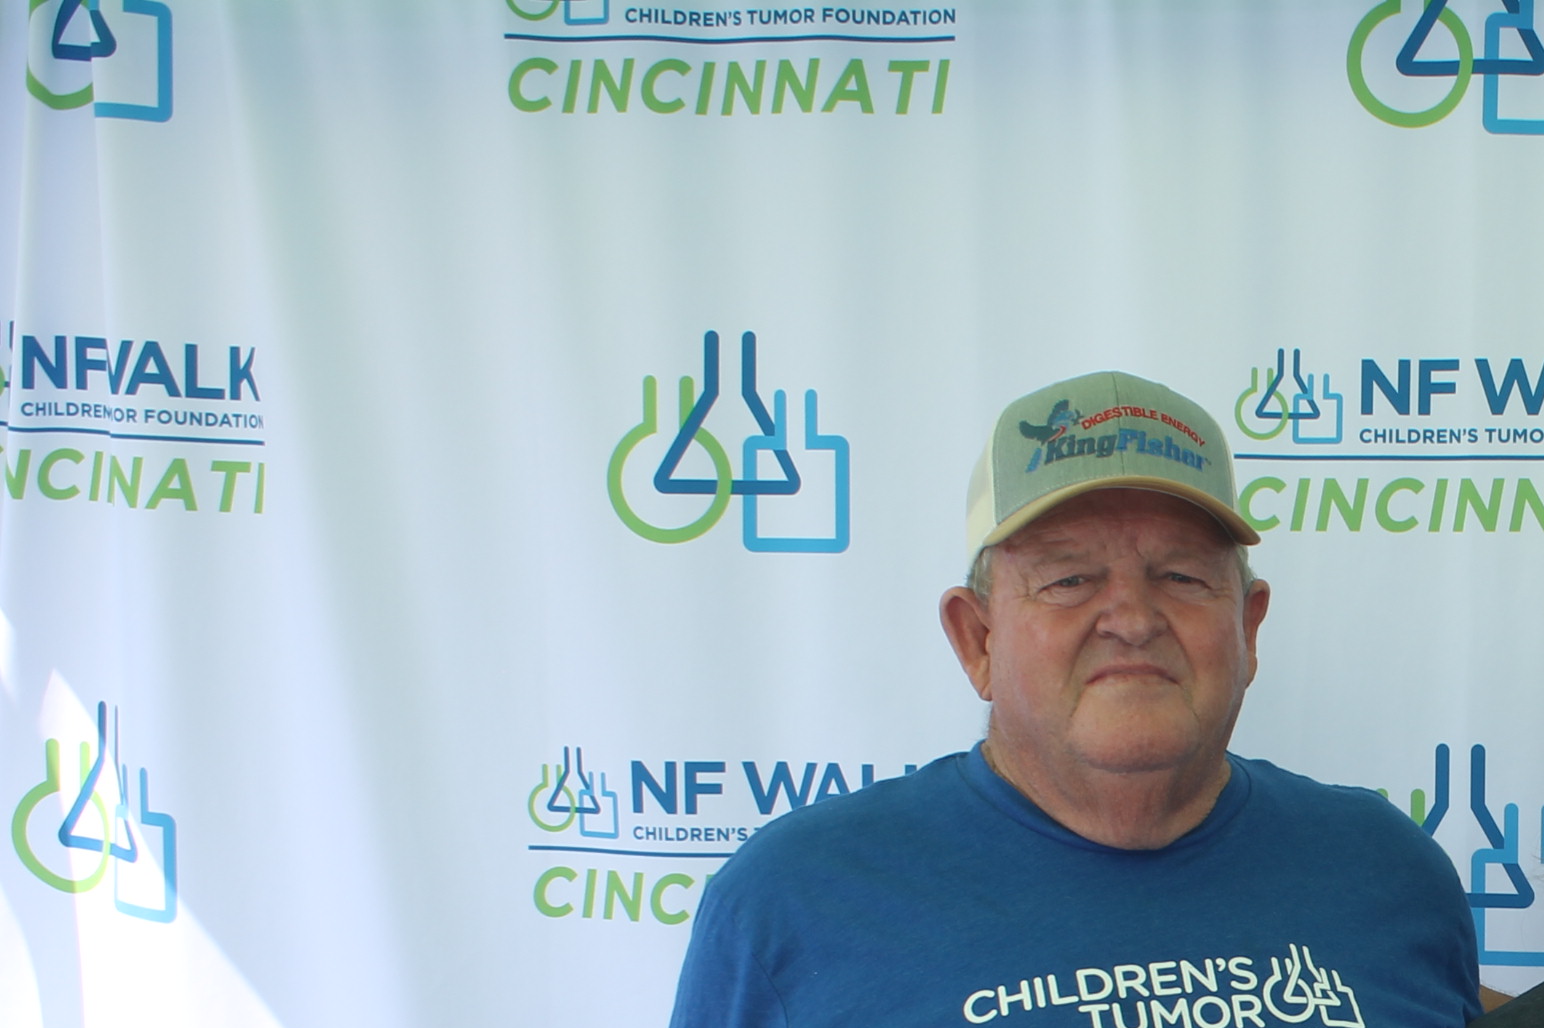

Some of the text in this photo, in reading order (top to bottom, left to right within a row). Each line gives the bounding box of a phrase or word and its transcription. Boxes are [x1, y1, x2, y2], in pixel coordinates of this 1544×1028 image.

[624, 7, 957, 27] CHILDREN'S TUMOR FOUNDATION
[507, 57, 951, 116] CINCINNATI
[21, 334, 107, 390] NF
[1360, 357, 1460, 416] NF
[144, 408, 264, 429] FOUNDATION
[1080, 406, 1206, 448] DIGESTIBLE ENERGY
[1359, 427, 1479, 445] CHILDREN'S
[1044, 427, 1206, 473] KingFisher
[630, 760, 726, 815] NF
[632, 825, 748, 843] CHILDREN'S
[963, 956, 1258, 1025] CHILDREN'S
